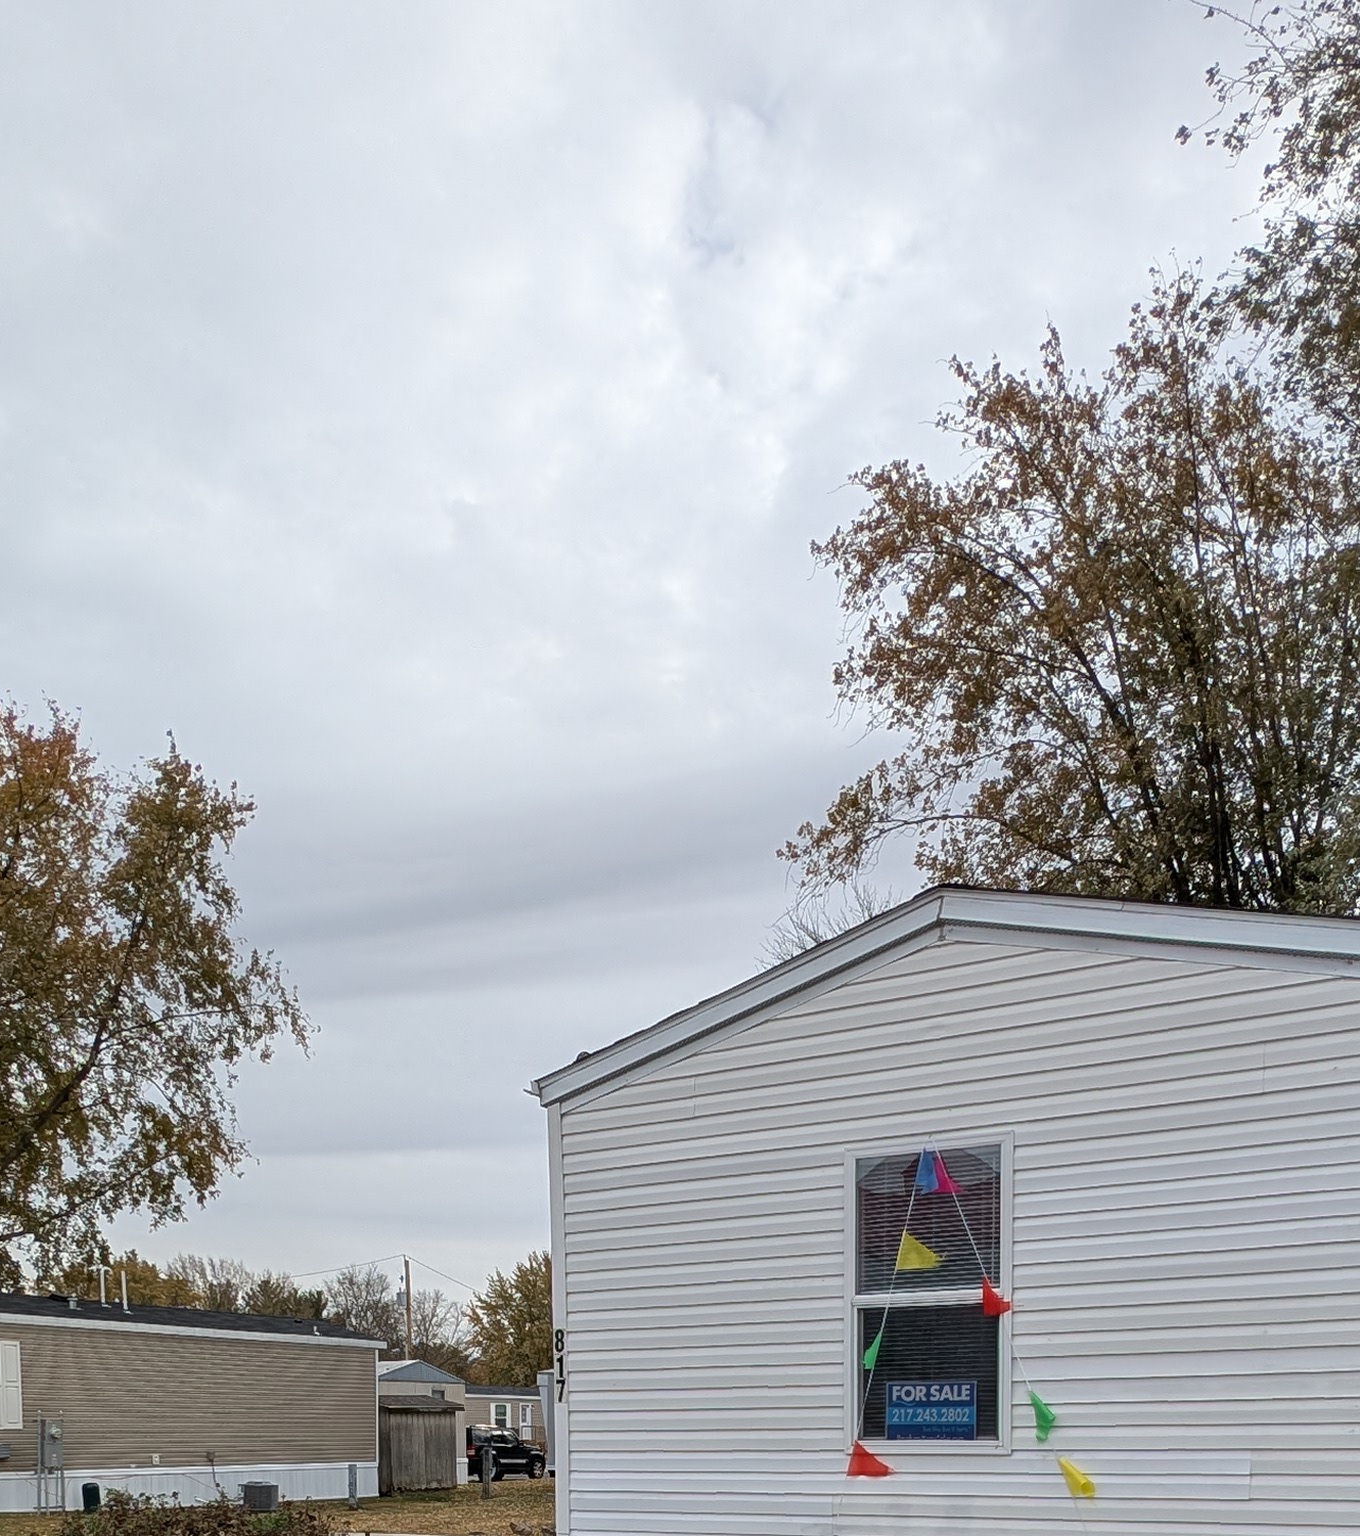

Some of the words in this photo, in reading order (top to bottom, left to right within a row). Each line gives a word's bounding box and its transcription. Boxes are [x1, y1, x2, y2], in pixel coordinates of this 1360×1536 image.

[554, 1328, 566, 1403] 817
[892, 1385, 927, 1402] FOR
[929, 1385, 971, 1401] SALE
[892, 1407, 970, 1422] 217.243.2802
